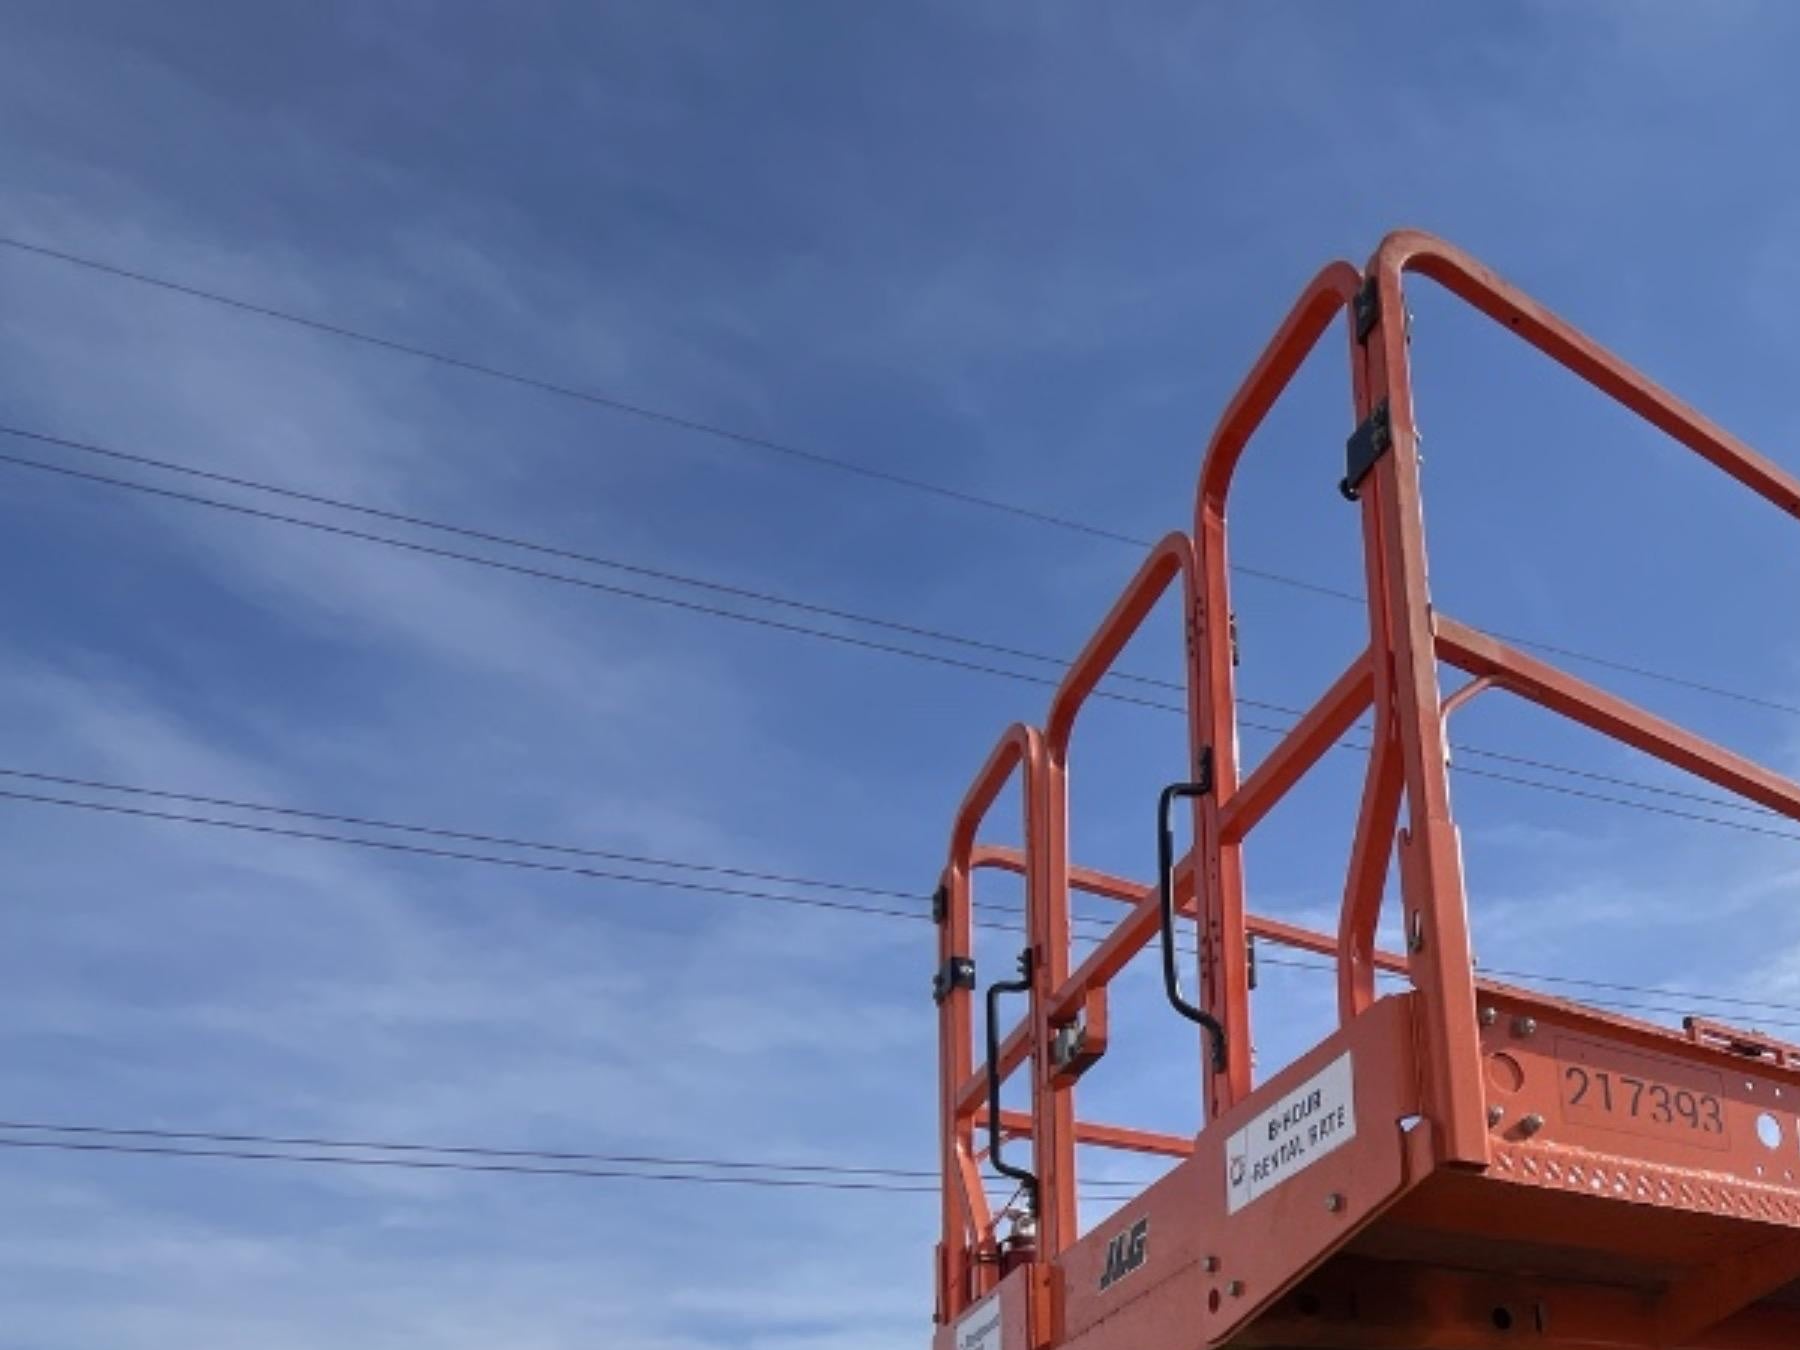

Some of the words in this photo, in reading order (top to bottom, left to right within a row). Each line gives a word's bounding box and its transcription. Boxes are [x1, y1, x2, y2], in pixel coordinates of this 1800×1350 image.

[1565, 1066, 1723, 1135] 217393
[1252, 1135, 1306, 1183] RENTAL
[1099, 1216, 1148, 1293] JLG
